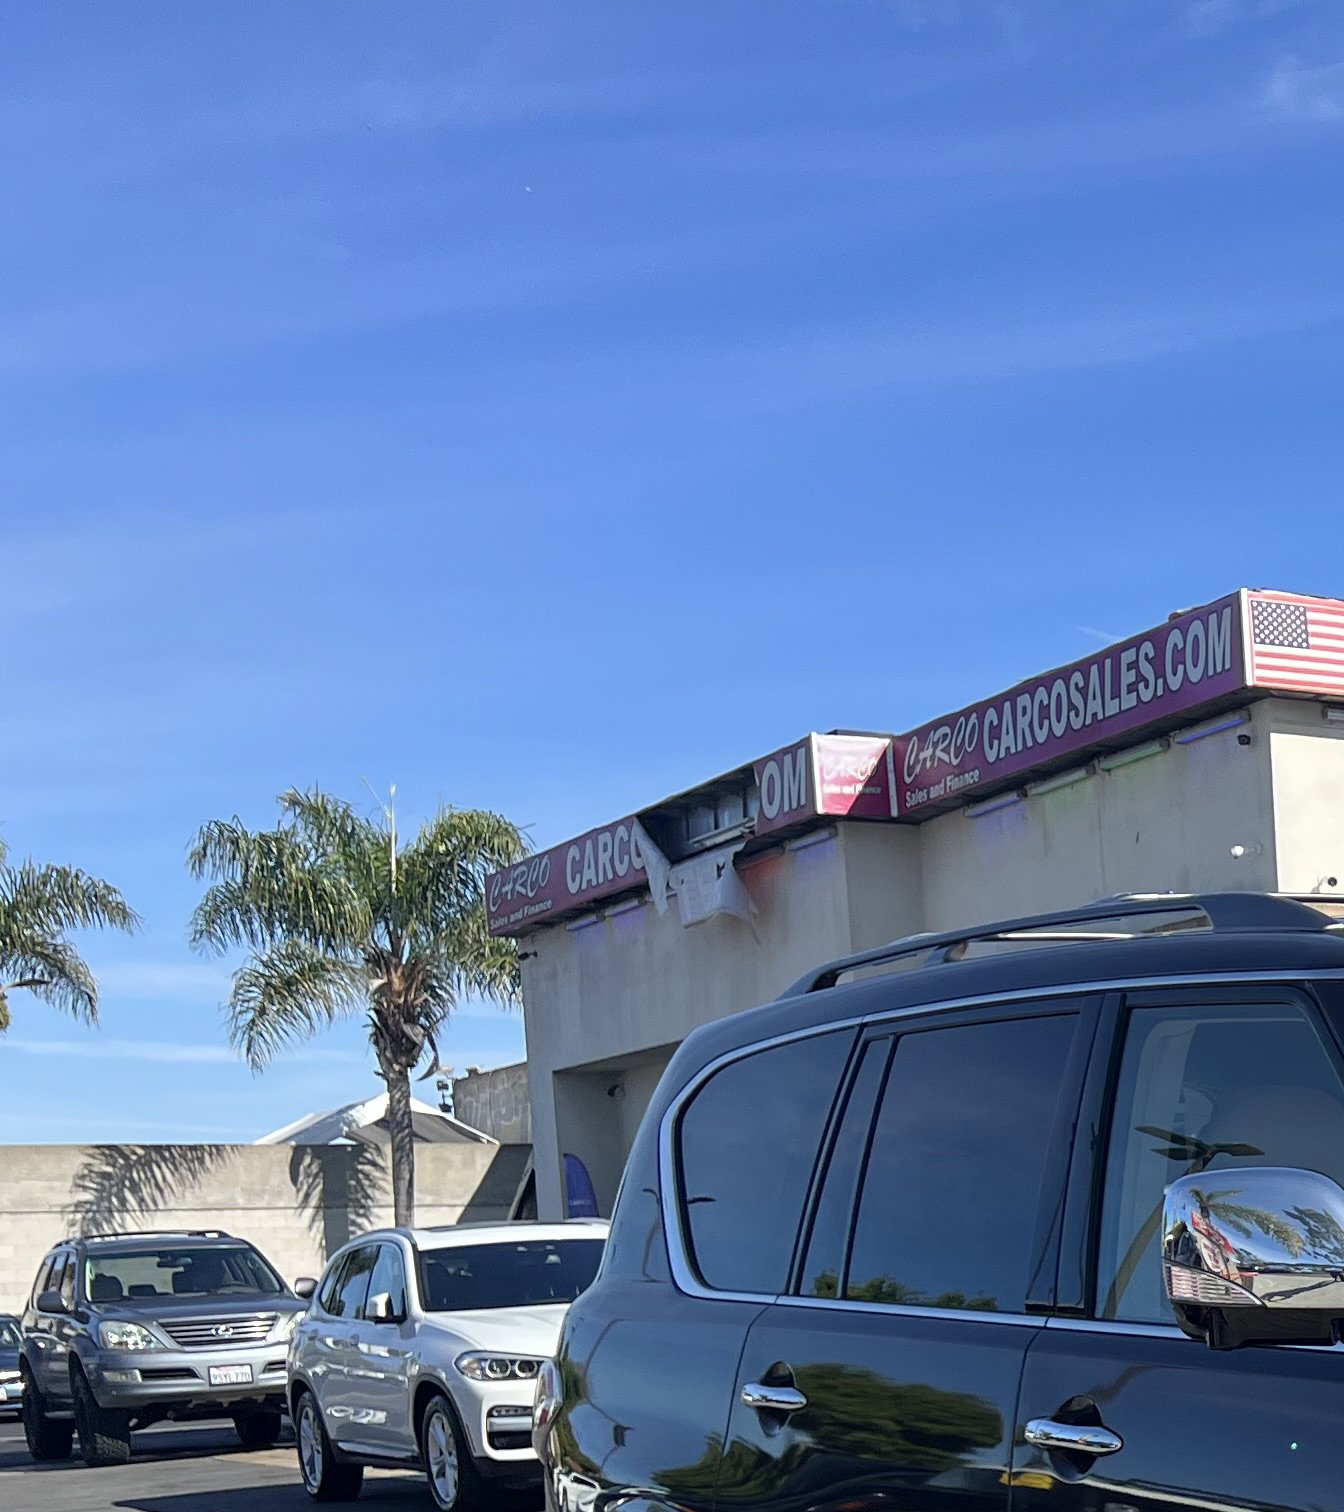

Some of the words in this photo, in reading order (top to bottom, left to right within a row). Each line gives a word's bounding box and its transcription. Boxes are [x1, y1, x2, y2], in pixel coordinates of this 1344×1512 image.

[983, 606, 1232, 763] CARCOSALES.COM
[904, 712, 978, 784] CARCO
[489, 855, 550, 912] CARCO
